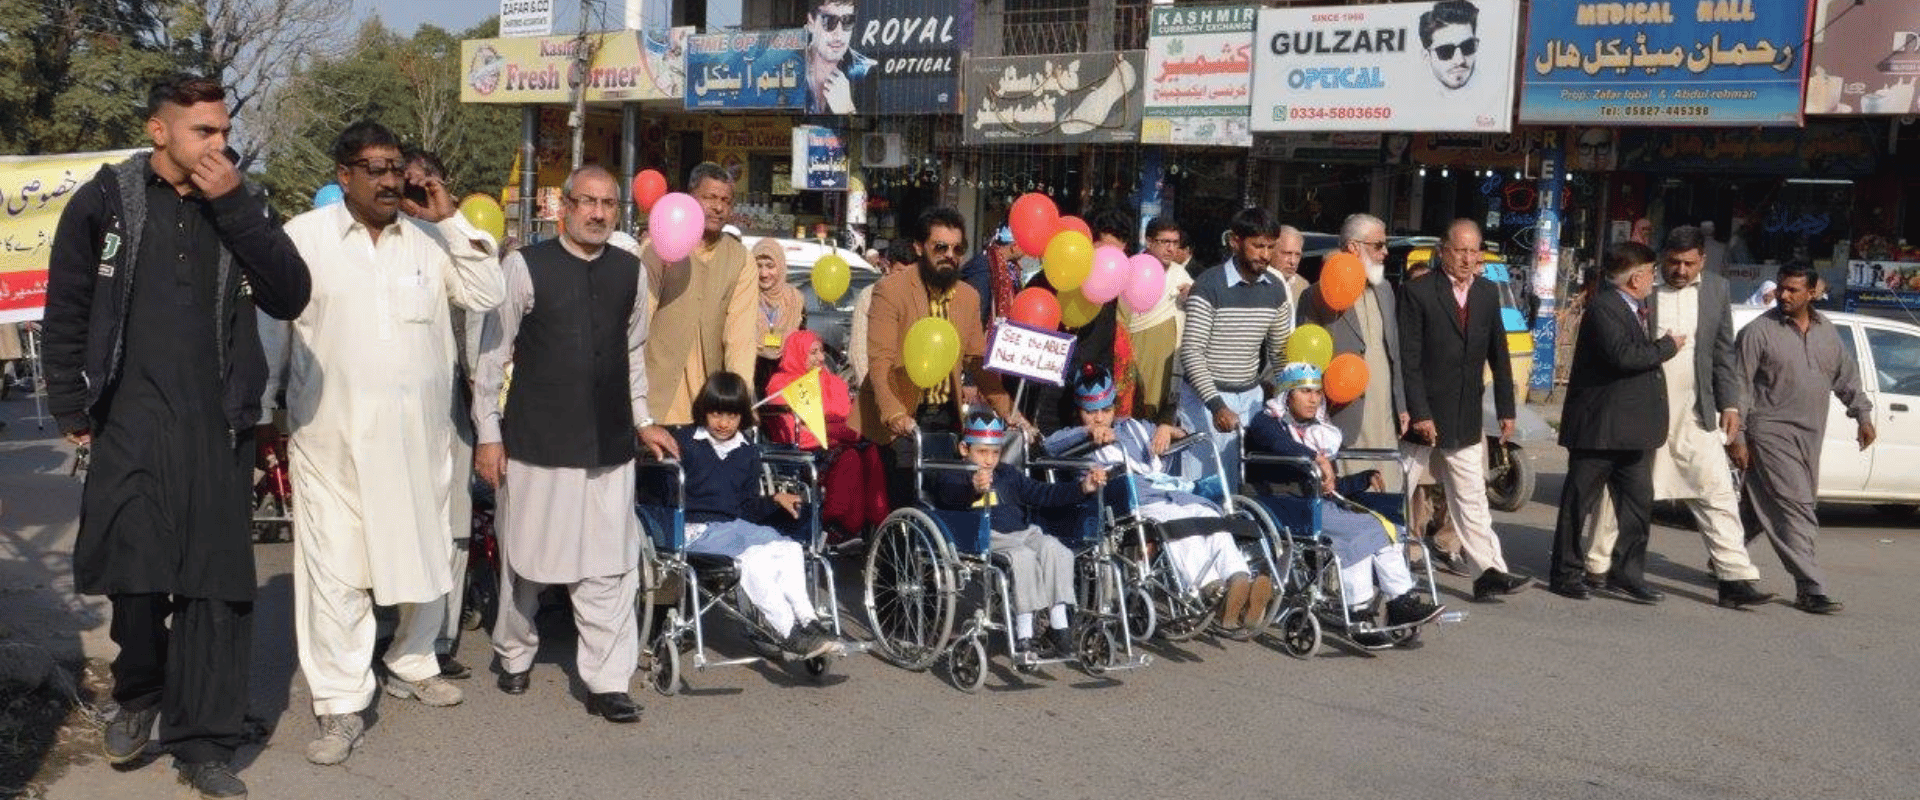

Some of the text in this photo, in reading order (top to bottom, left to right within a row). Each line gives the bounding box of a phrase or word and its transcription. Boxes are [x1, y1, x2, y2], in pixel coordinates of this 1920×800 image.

[1157, 9, 1253, 26] KASHMIR
[1311, 13, 1339, 22] SINCE
[1577, 0, 1756, 25] MEDICAL HALL
[861, 15, 954, 46] ROYAL
[1158, 22, 1252, 33] CURRENCY EXCHANGE
[688, 34, 729, 54] TIME
[1270, 28, 1407, 55] GULZARI
[1583, 31, 1685, 74] میڈیکل
[1687, 34, 1792, 73] رحمان
[885, 56, 952, 73] OPTICAL
[1153, 42, 1251, 83] کشمیر
[506, 63, 561, 91] Fresh
[1287, 66, 1384, 90] OPTICAL
[1290, 107, 1391, 119] 0334-5803650
[1601, 106, 1620, 115] Tel:
[1002, 329, 1068, 356] SEE the ABLE
[996, 348, 1015, 362] Not
